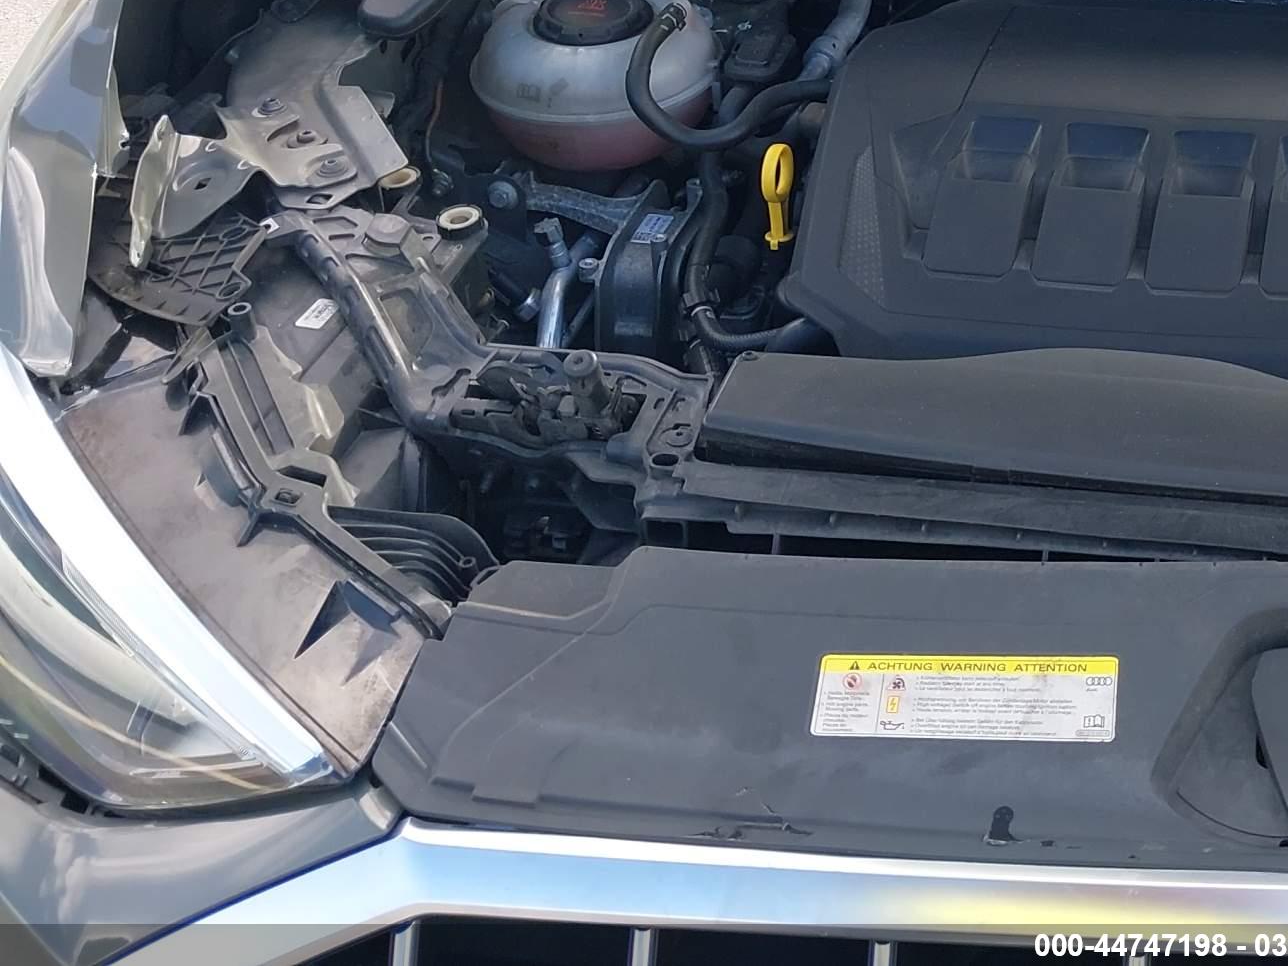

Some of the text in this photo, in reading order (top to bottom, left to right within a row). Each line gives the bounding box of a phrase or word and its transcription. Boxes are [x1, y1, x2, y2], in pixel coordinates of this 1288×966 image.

[866, 661, 1088, 672] ACHTUNG WARNING ATTENTION
